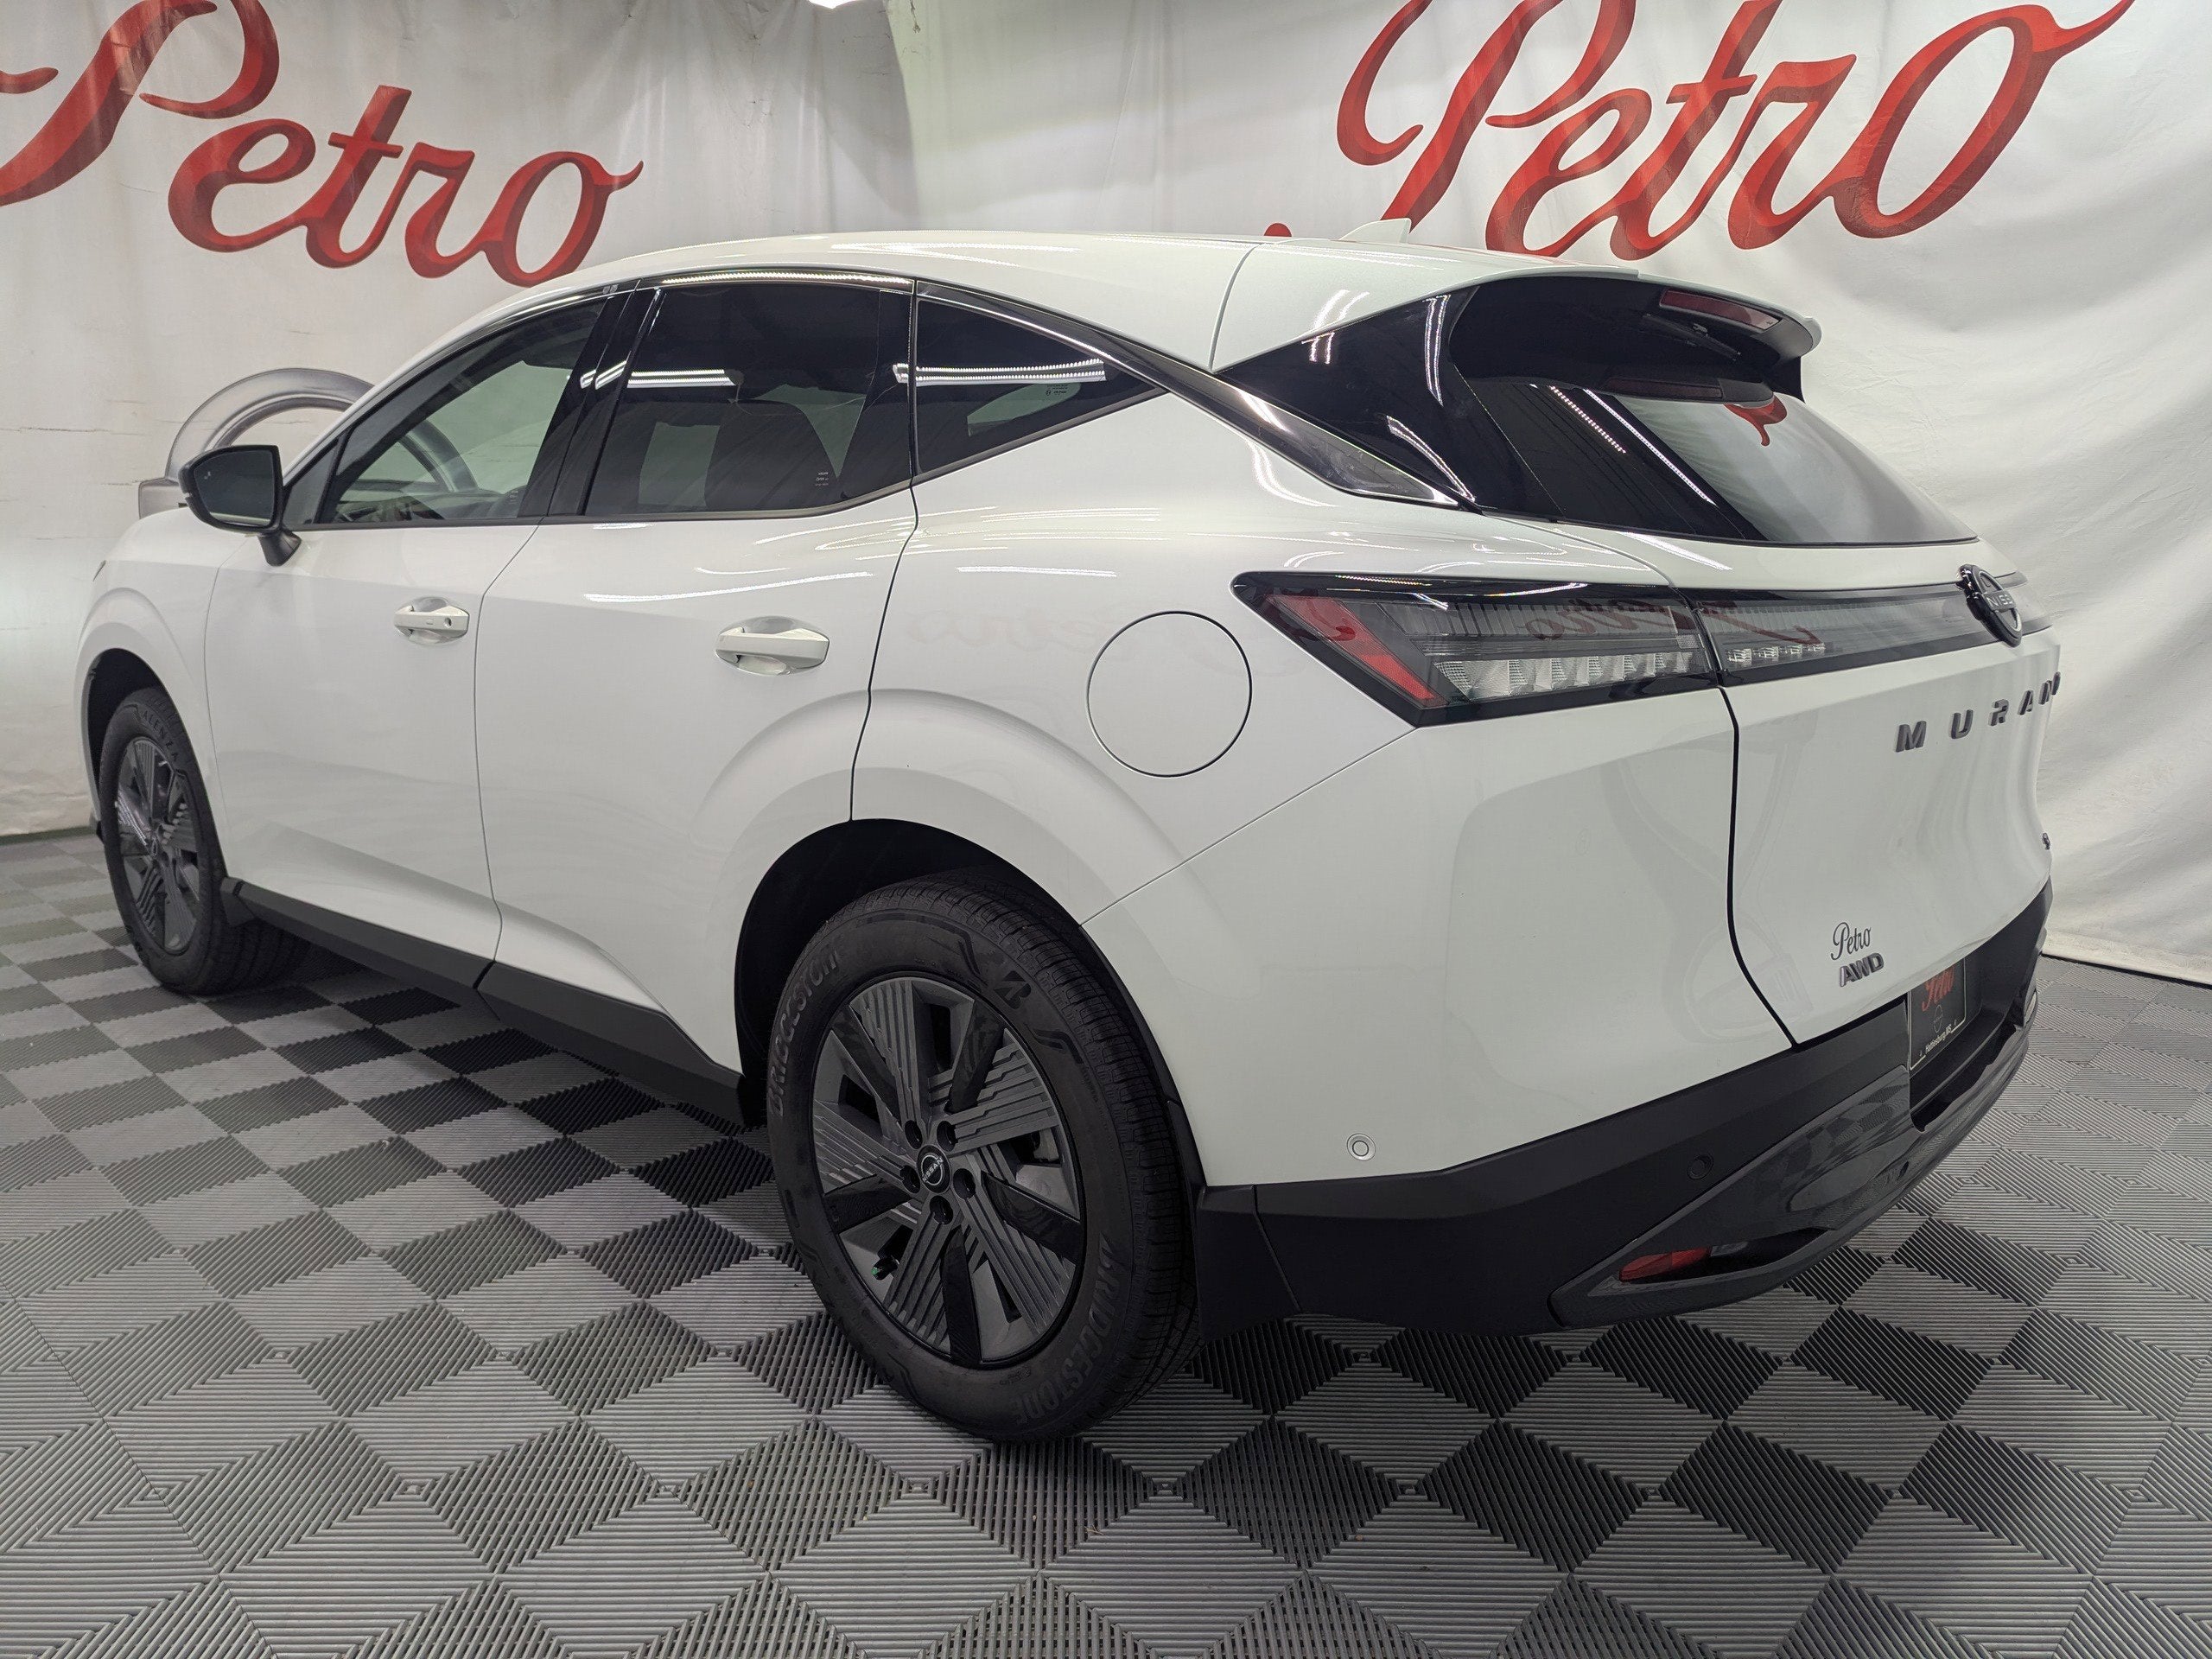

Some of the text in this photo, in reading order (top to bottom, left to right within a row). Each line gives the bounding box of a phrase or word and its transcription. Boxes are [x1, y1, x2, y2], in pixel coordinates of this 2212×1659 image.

[0, 0, 644, 289] Petro
[1264, 0, 2133, 261] Petro
[1986, 594, 2014, 607] NISS
[1830, 921, 1872, 960] Petro
[1840, 952, 1885, 987] AWD
[766, 941, 840, 1118] BRIDGESTON
[922, 1157, 944, 1183] NISSAN
